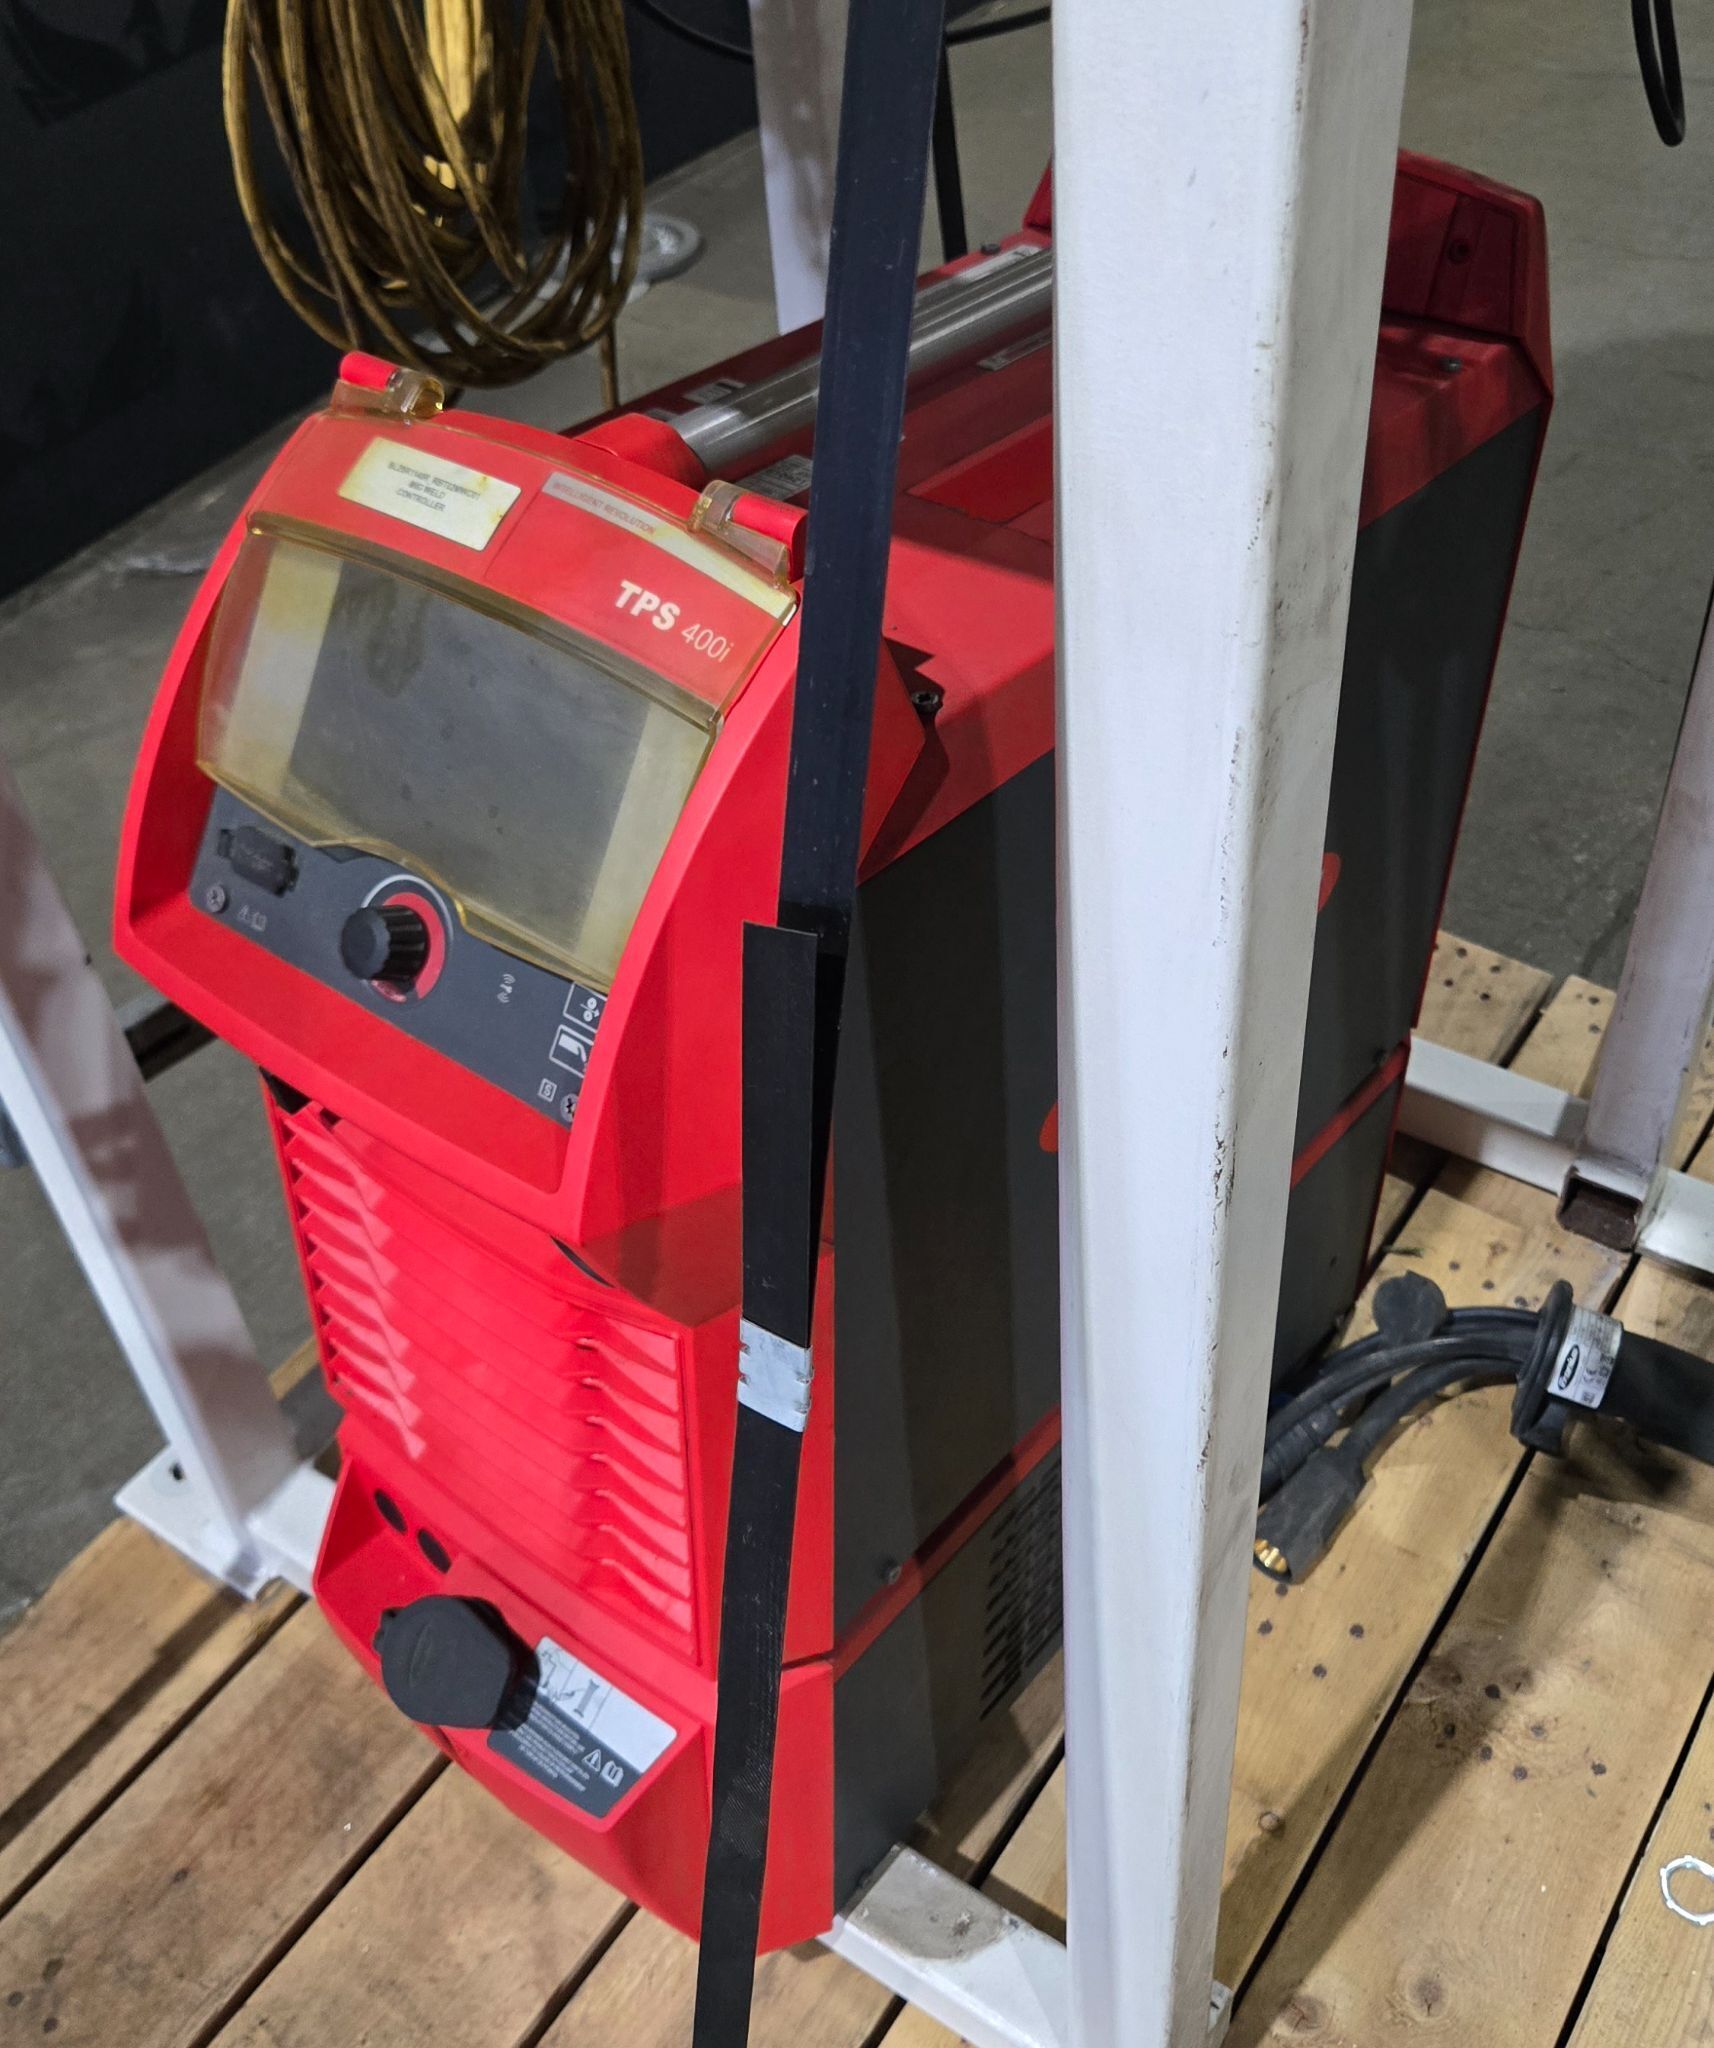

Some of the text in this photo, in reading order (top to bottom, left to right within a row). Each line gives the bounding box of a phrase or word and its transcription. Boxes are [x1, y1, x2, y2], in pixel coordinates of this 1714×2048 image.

[396, 488, 446, 511] CONTROLLER
[615, 579, 734, 663] TPS 400i
